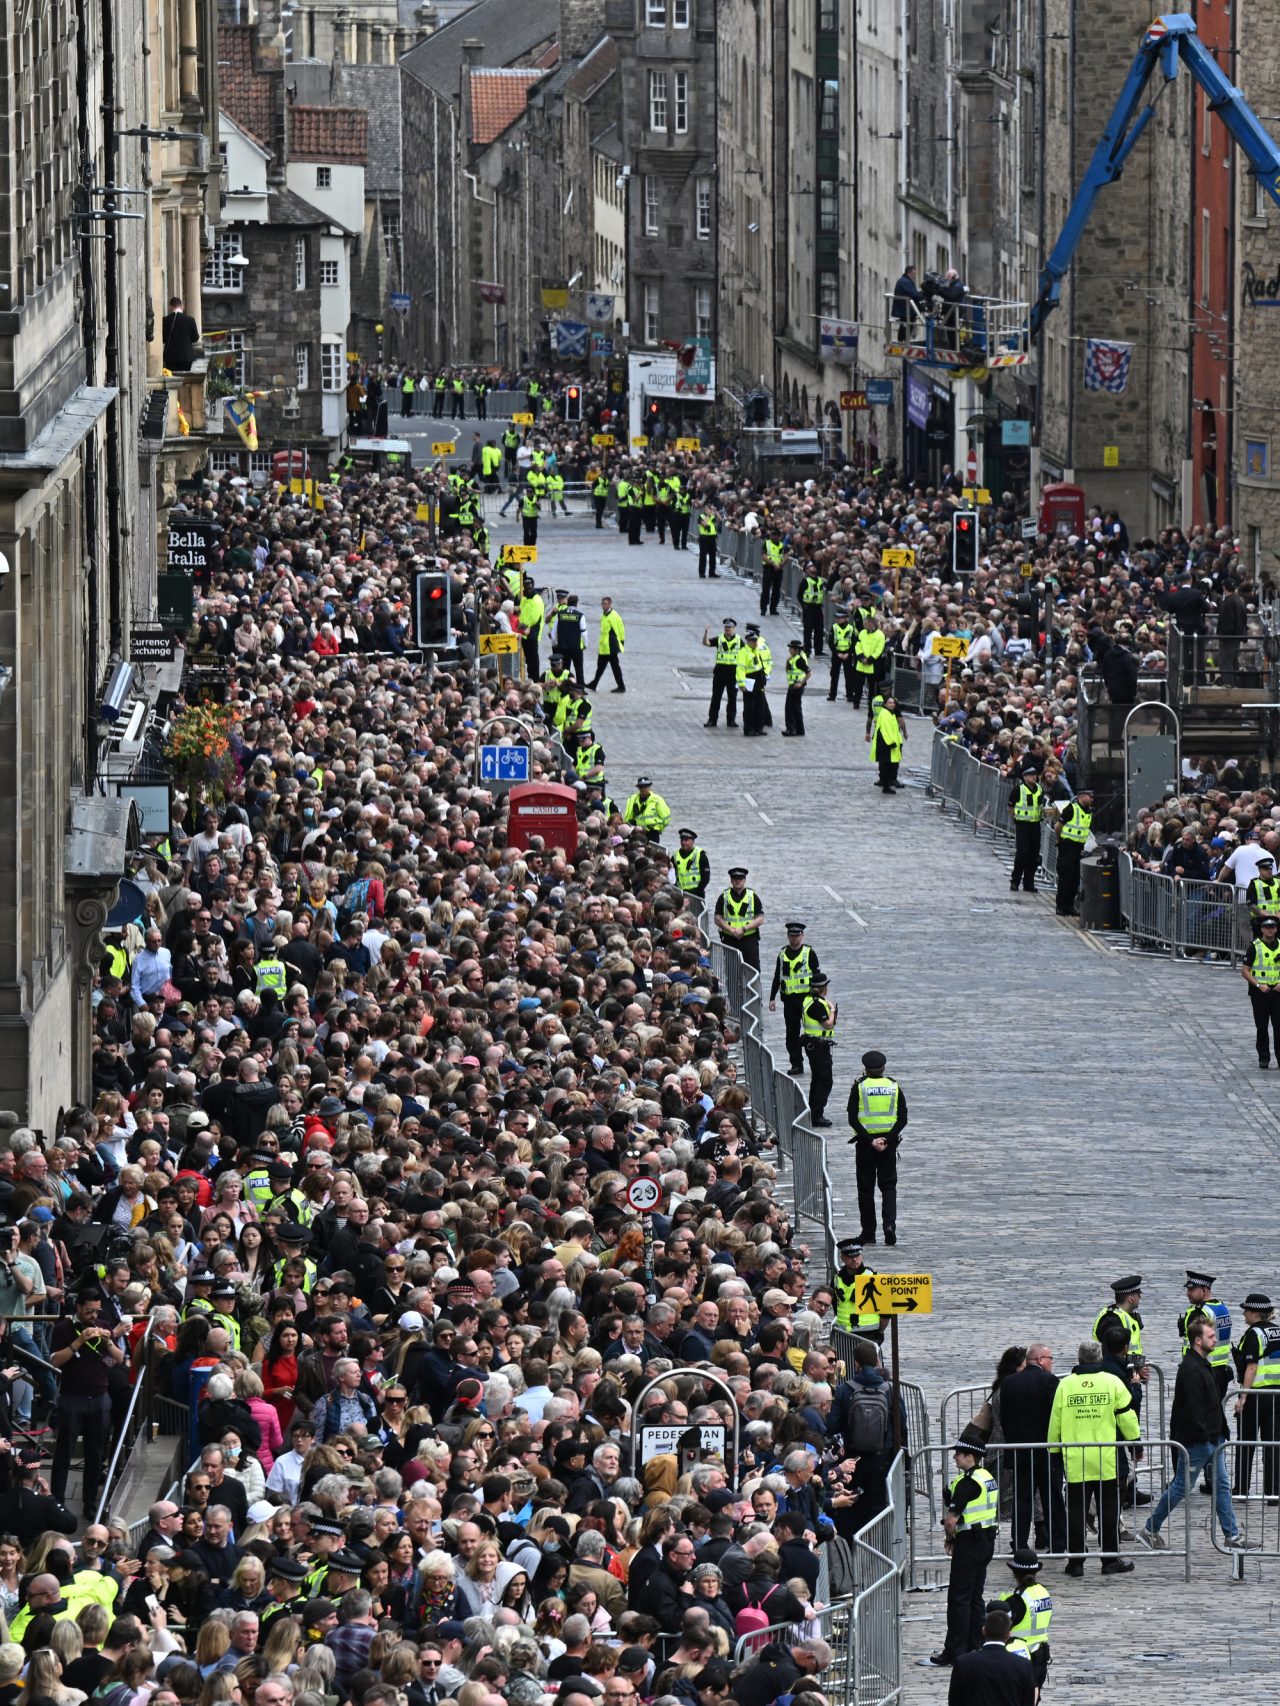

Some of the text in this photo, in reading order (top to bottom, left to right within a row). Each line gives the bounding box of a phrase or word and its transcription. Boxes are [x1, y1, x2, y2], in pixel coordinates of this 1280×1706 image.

[168, 531, 206, 547] Bella
[167, 550, 207, 565] Italia
[130, 638, 170, 652] Currency
[130, 647, 171, 655] Exchange
[250, 1179, 270, 1187] POLIC
[880, 1277, 929, 1286] CROSSING
[890, 1287, 918, 1295] POINT
[1069, 1394, 1107, 1405] EVENT STAFF
[648, 1430, 719, 1440] PEDESIAN
